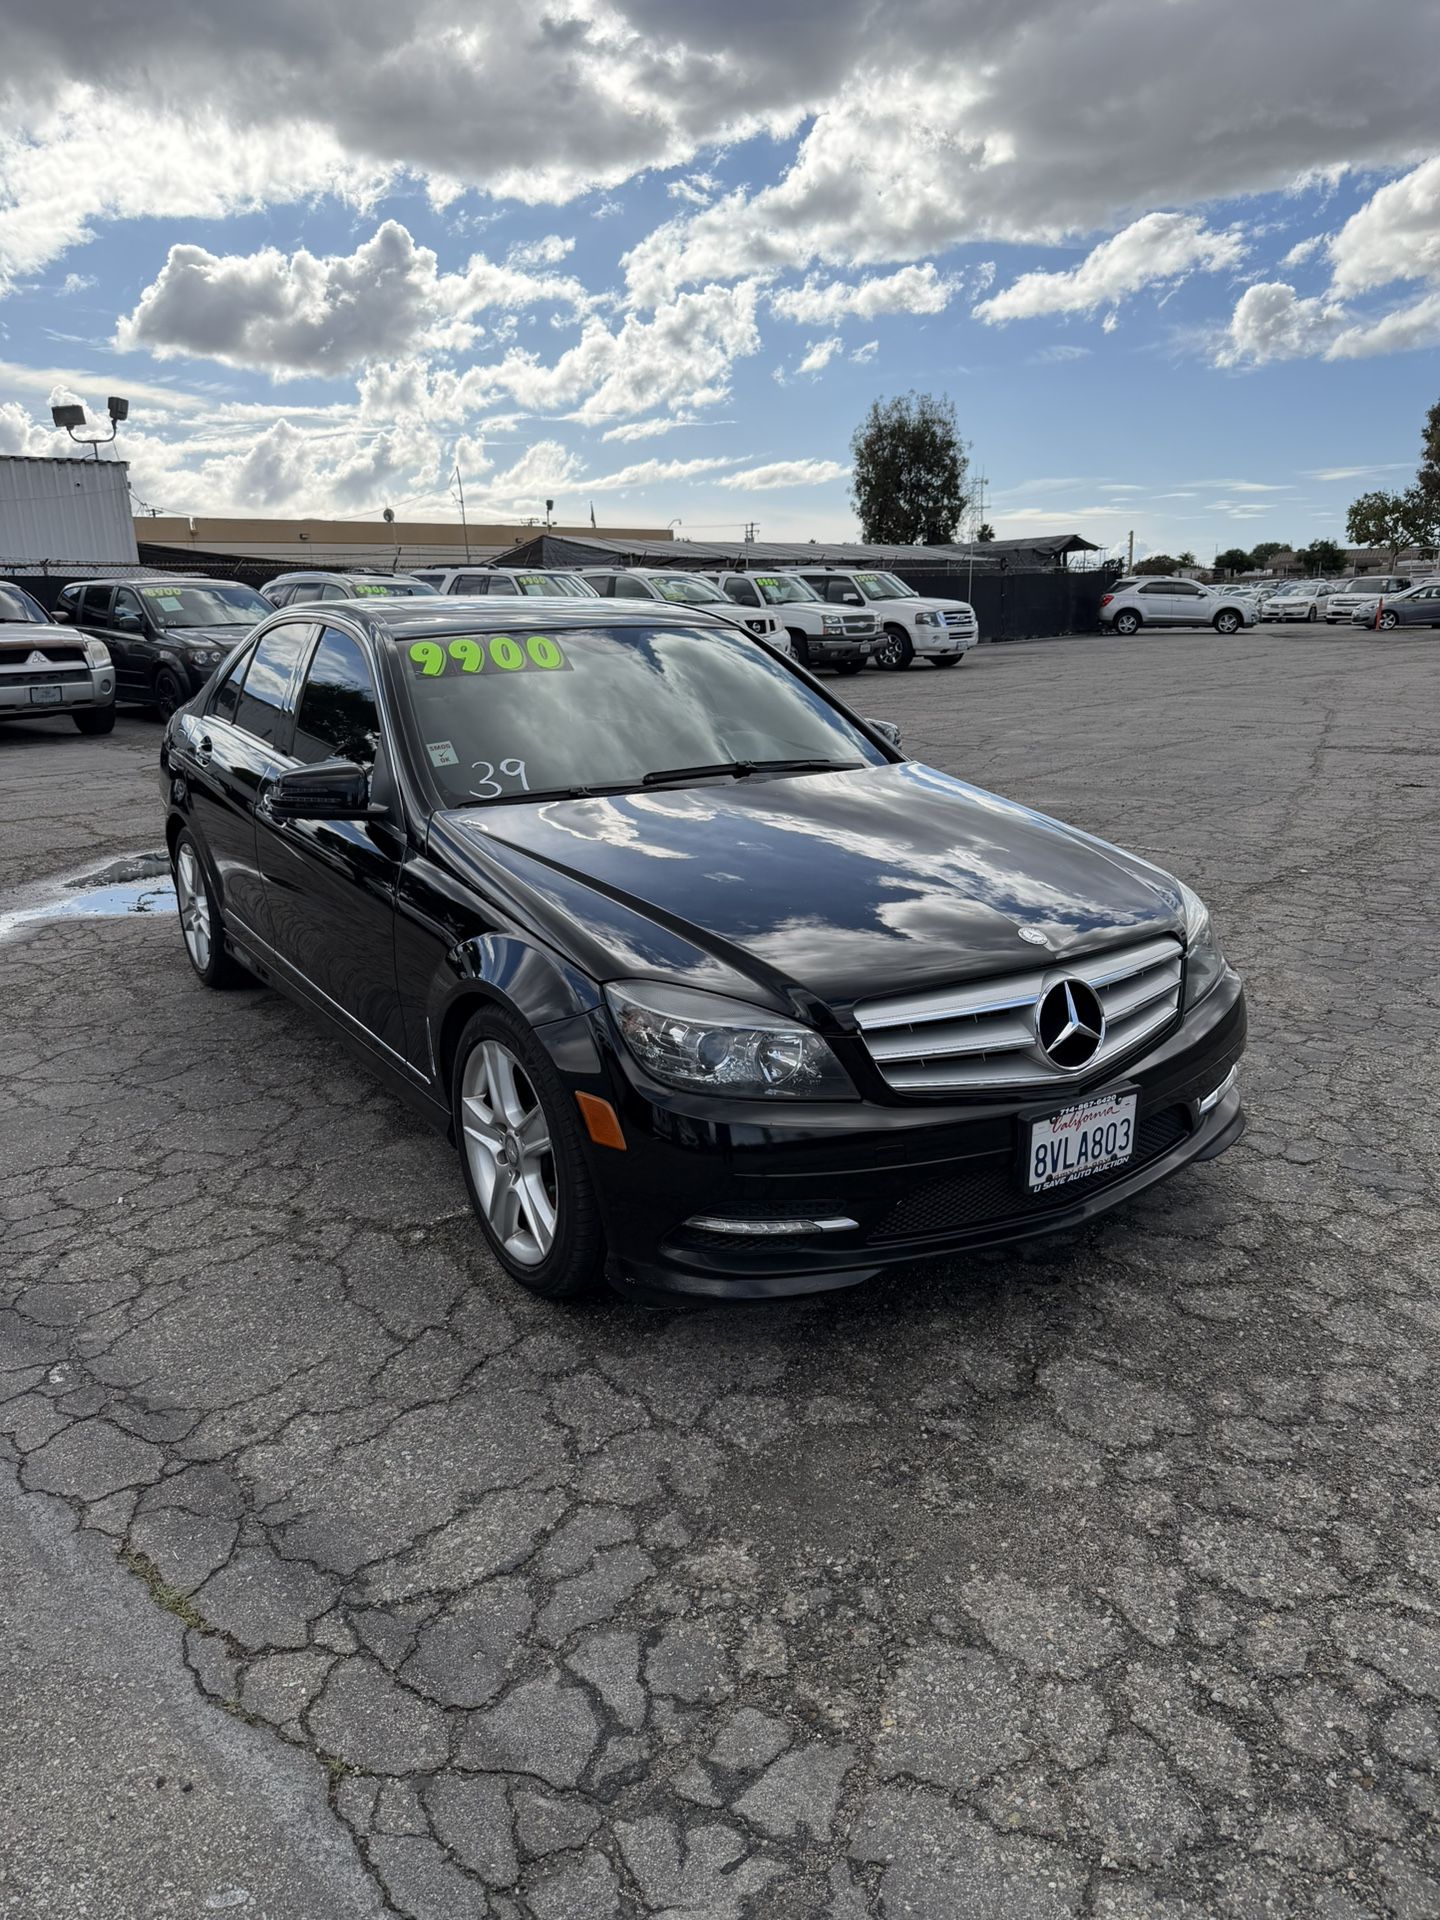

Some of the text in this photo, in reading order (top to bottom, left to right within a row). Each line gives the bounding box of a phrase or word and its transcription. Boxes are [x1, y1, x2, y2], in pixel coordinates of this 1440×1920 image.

[356, 585, 388, 594] 9900
[409, 635, 565, 677] 9900
[430, 743, 451, 752] SMOG
[469, 758, 530, 798] 39
[1052, 1106, 1120, 1133] California
[1034, 1118, 1131, 1178] 8VLA803
[1033, 1155, 1130, 1193] U SAVE AUTO AUCTION
